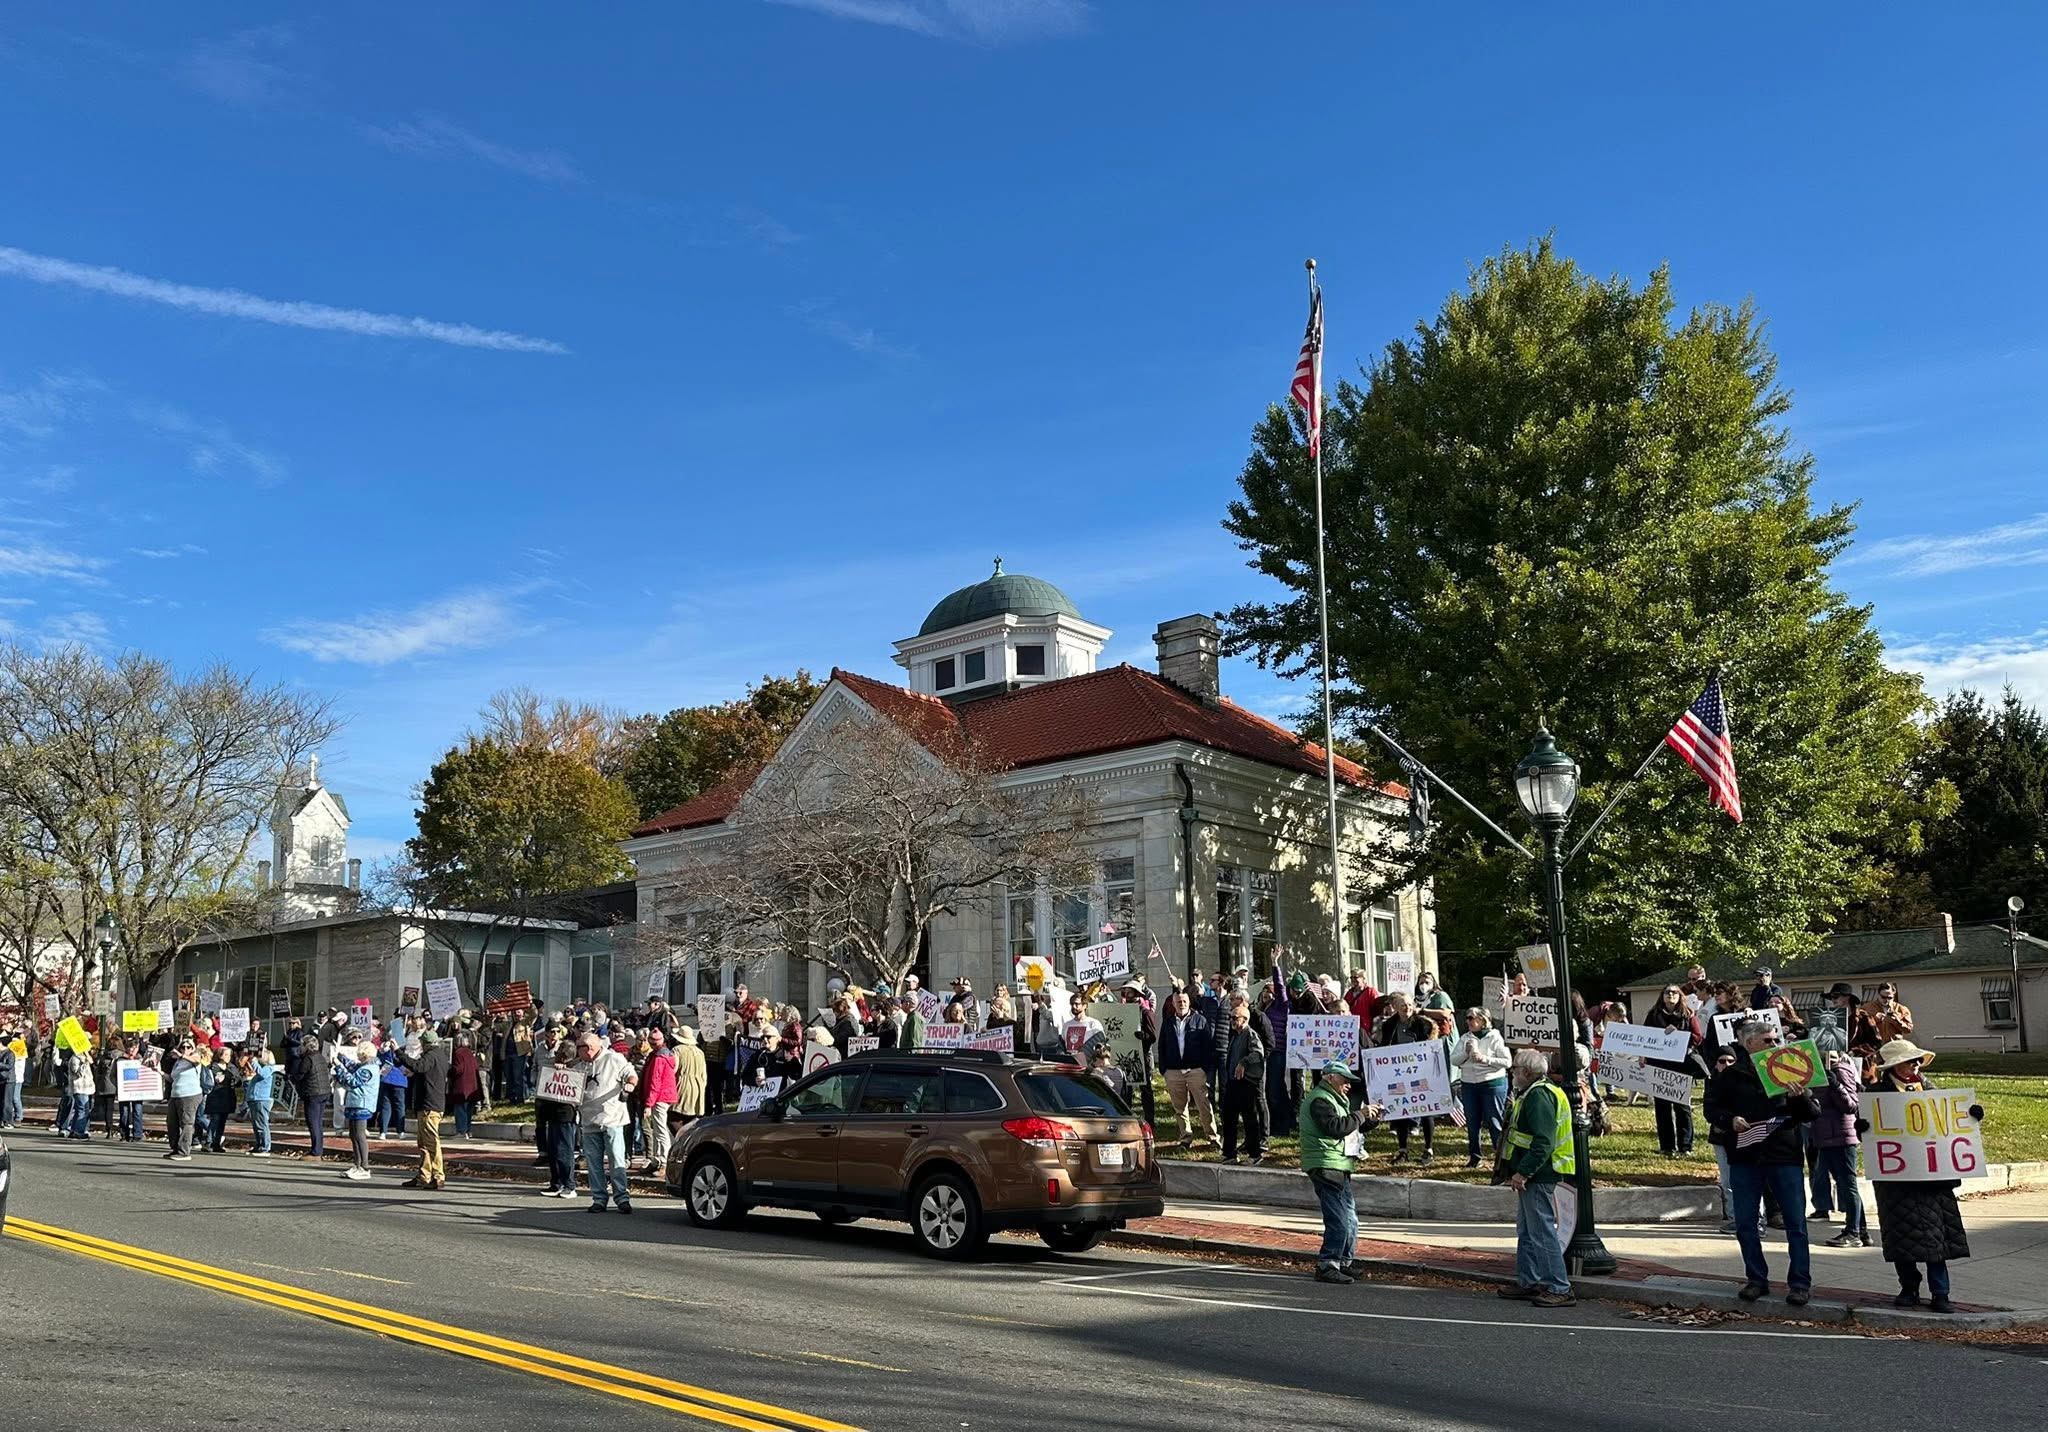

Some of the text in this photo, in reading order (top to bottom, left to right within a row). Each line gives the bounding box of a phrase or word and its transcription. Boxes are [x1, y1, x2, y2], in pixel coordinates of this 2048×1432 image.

[1088, 944, 1114, 962] STOP
[1093, 958, 1110, 967] THE
[1080, 961, 1125, 981] CORRUPTION
[923, 995, 936, 1007] NO
[1512, 999, 1559, 1014] Protect
[221, 1010, 246, 1019] ALEXA
[1763, 1013, 1771, 1023] IS
[354, 1017, 368, 1025] USA
[926, 1026, 960, 1038] TRUMP
[1291, 1039, 1355, 1048] DEMOCRACY
[1376, 1057, 1389, 1065] NO
[1600, 1054, 1613, 1066] DUE
[1394, 1066, 1418, 1076] X-47
[553, 1072, 569, 1084] NO
[1653, 1068, 1689, 1087] FREEDOM
[544, 1082, 577, 1098] KINGS
[747, 1081, 775, 1093] STAND
[1652, 1083, 1686, 1100] TYRANNY
[1394, 1094, 1426, 1105] TACO
[1402, 1103, 1440, 1116] A-HOLE
[1872, 1096, 1974, 1137] LOVE
